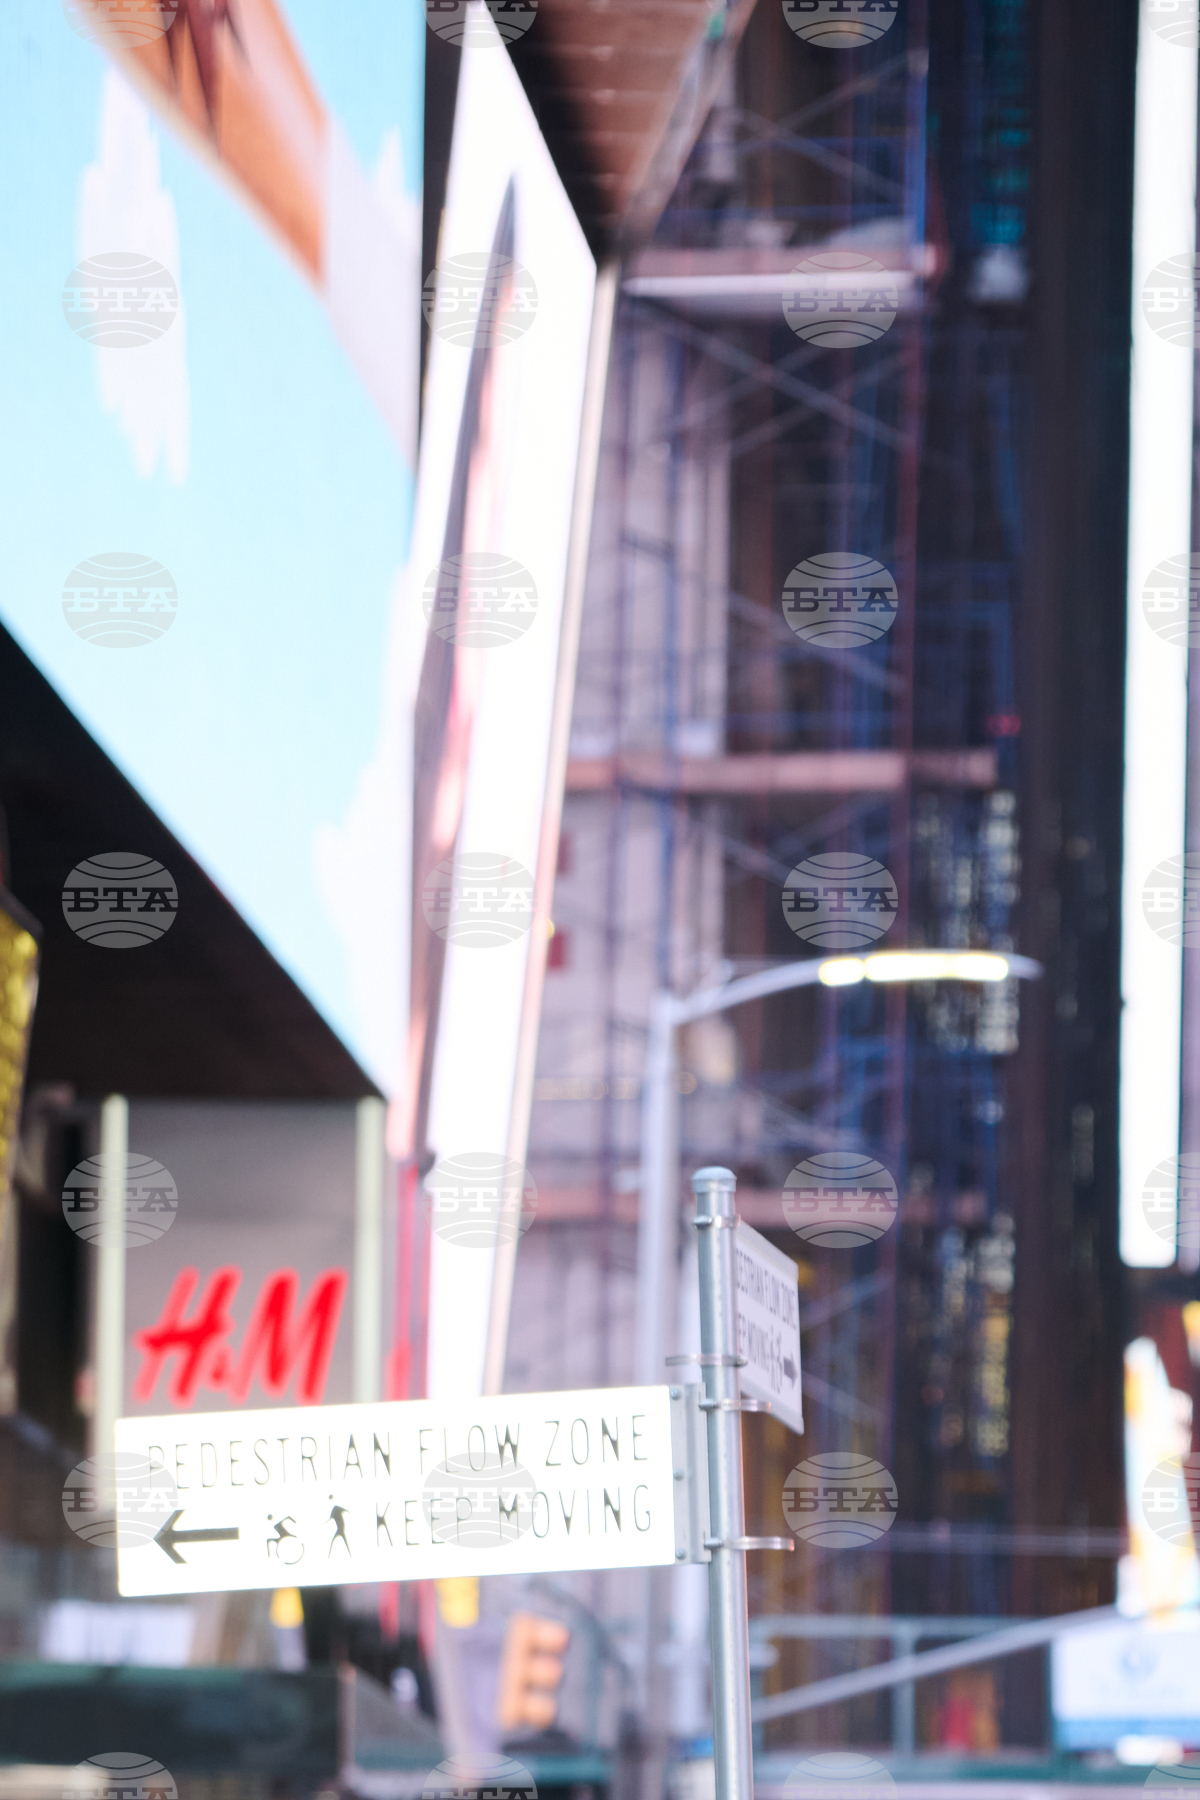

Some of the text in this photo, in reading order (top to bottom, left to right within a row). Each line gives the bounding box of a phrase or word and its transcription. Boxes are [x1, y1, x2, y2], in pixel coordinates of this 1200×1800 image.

[133, 1263, 350, 1407] H&M
[146, 1414, 650, 1491] PEDESTRIAN FLOW ZONE
[374, 1484, 653, 1549] KEEP MOVING
